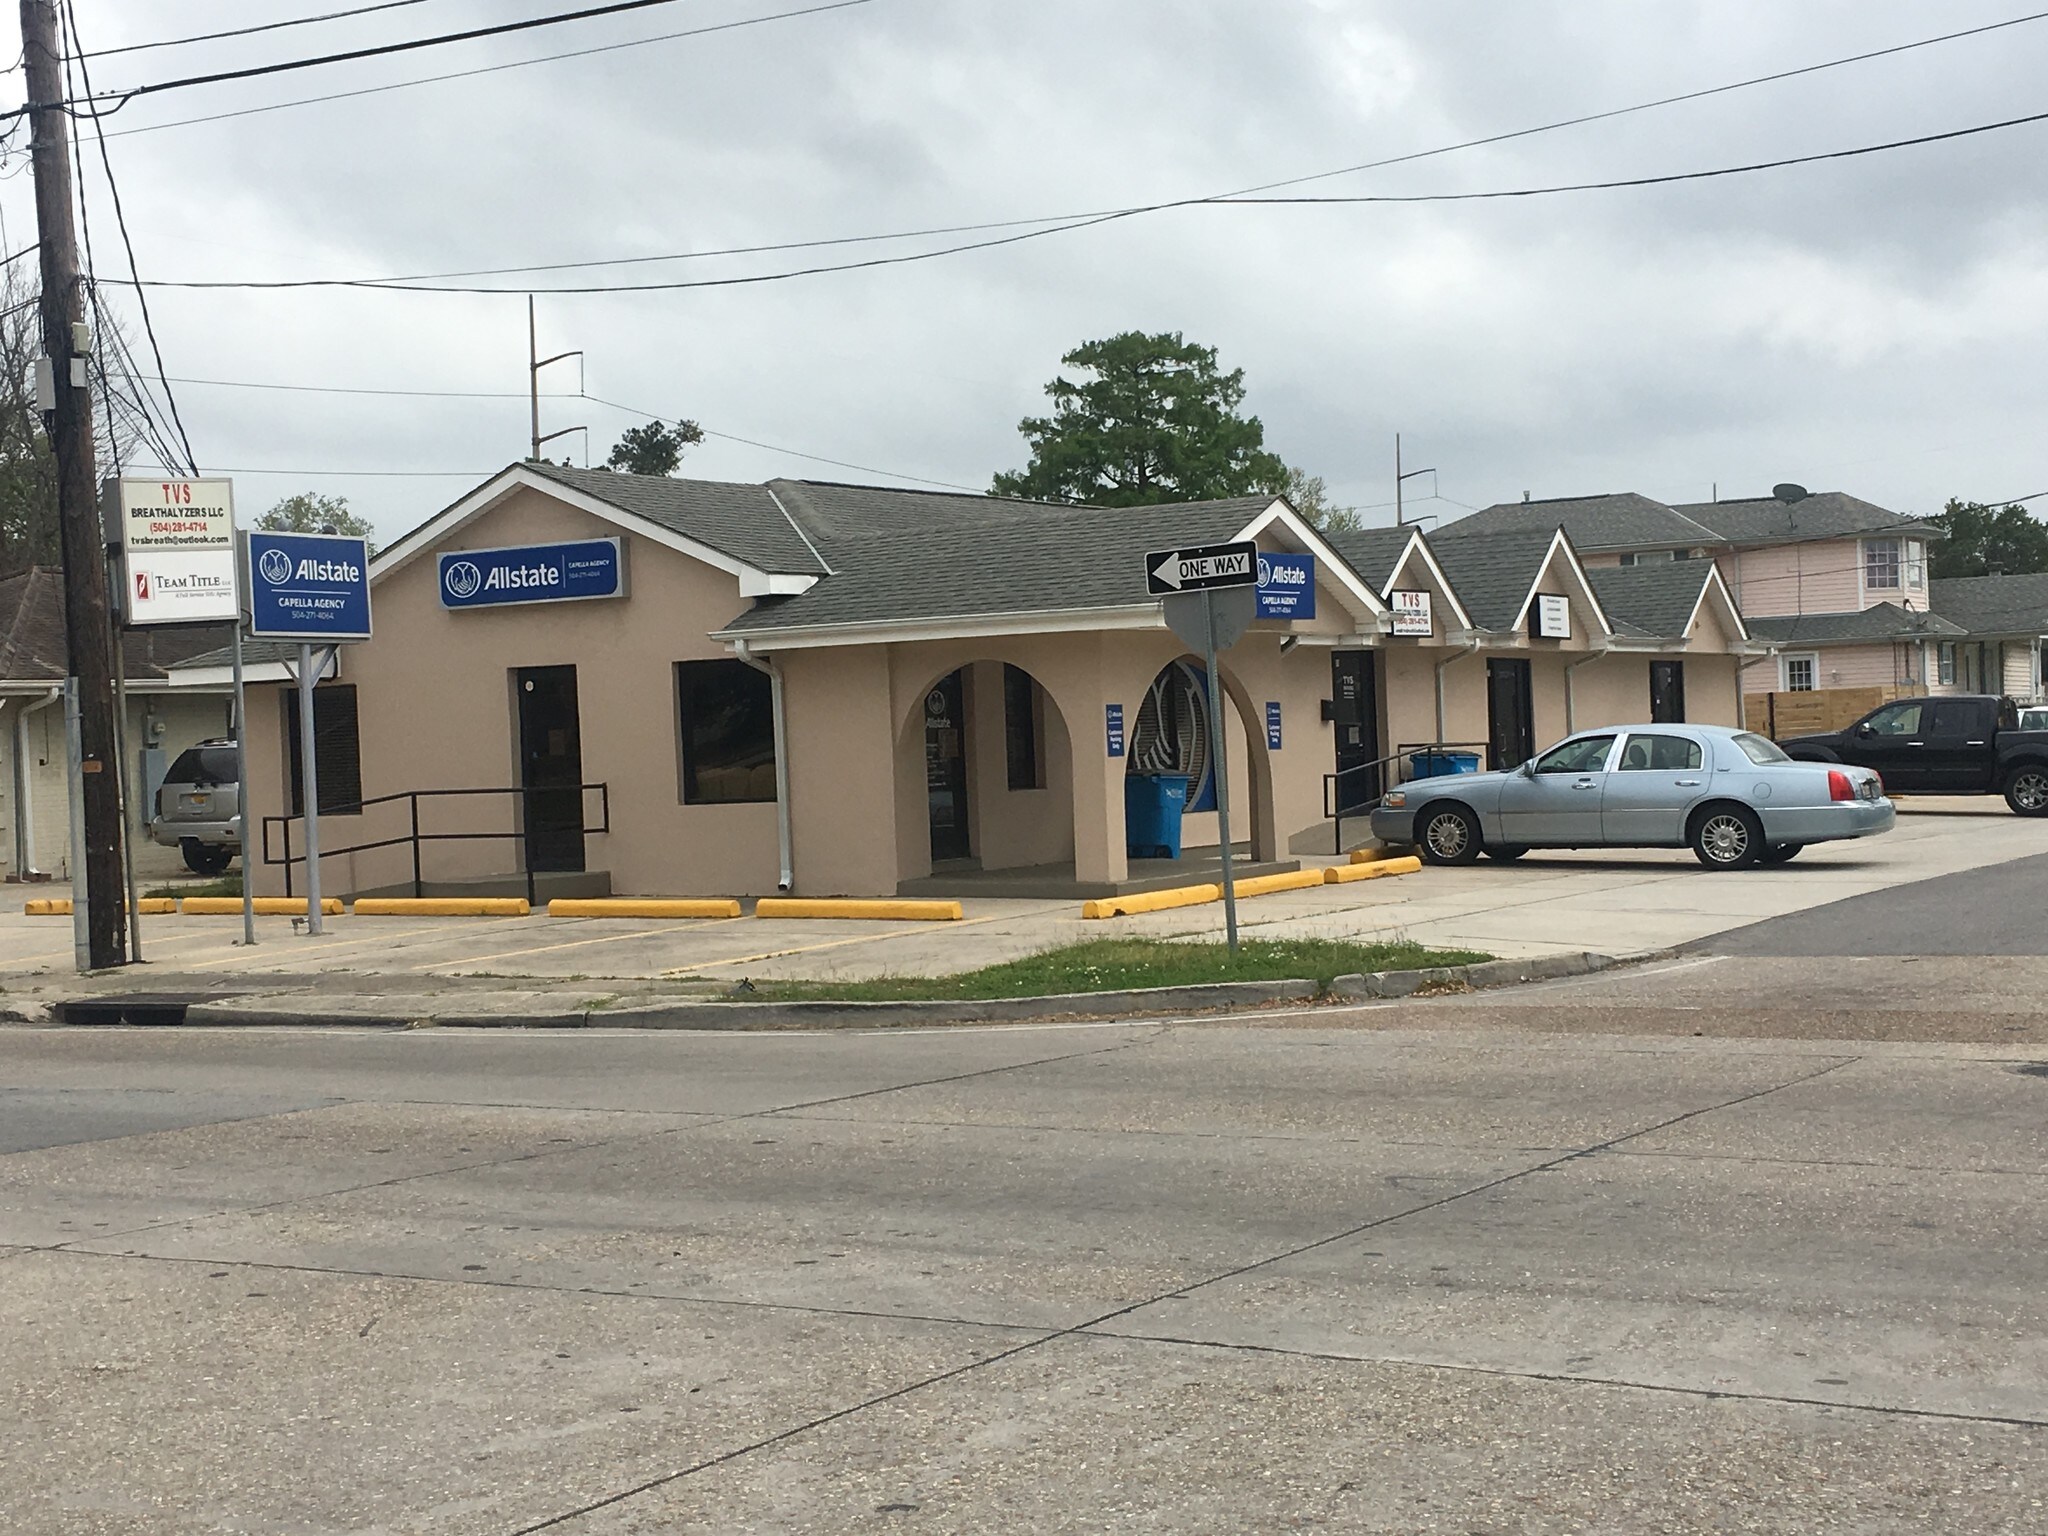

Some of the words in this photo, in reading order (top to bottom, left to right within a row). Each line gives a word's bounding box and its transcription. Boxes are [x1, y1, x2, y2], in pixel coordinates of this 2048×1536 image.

[162, 484, 191, 504] TVS
[131, 507, 207, 518] BREATHALYZERS
[208, 507, 224, 517] LLC
[172, 522, 207, 532] 281-4714
[131, 536, 229, 545] tvsbreath@outlook.com
[295, 559, 360, 583] Allstate
[568, 561, 589, 569] CAPELLA
[590, 559, 609, 567] AGENCY
[1179, 560, 1209, 578] ONE
[1214, 555, 1245, 574] WAY
[155, 575, 187, 588] TEAM
[189, 574, 220, 587] TITLE
[484, 563, 559, 591] Allstate
[1271, 565, 1305, 585] Allstate
[278, 597, 313, 607] CAPELLA
[314, 599, 345, 609] AGENCY
[1401, 593, 1420, 608] TVS
[292, 611, 334, 620] 504-271-4064
